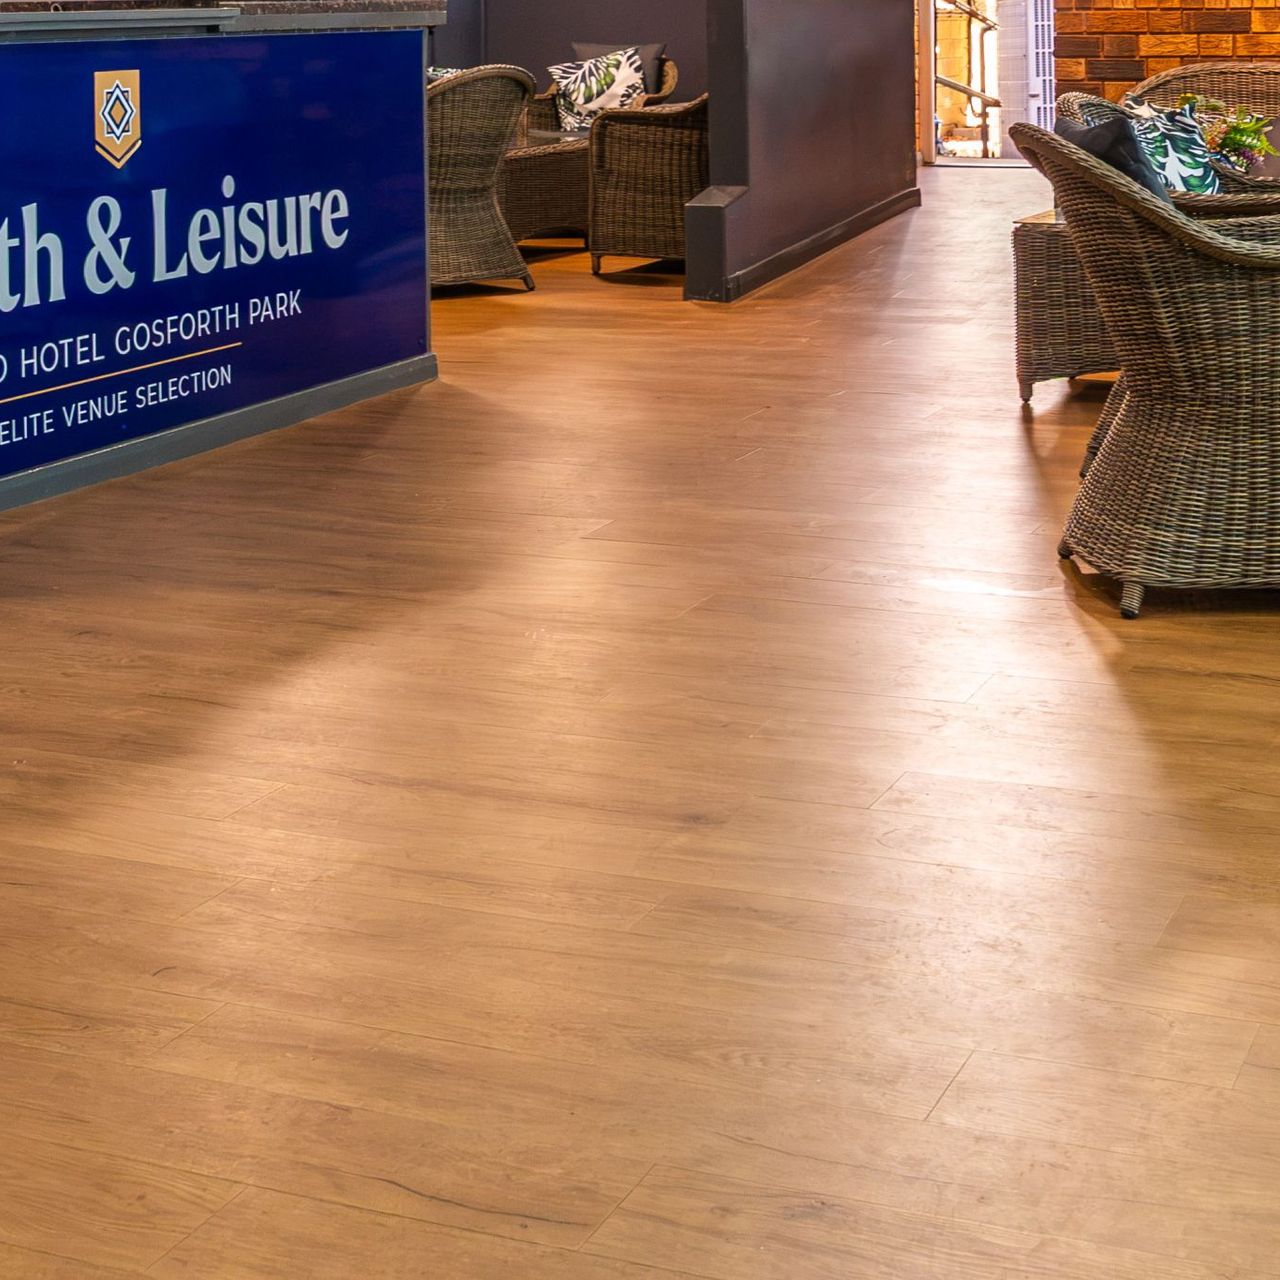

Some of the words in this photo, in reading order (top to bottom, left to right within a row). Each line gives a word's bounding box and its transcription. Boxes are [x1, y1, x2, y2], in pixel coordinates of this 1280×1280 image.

[83, 195, 136, 295] &
[151, 174, 350, 283] Leisure
[20, 332, 106, 378] HOTEL
[114, 302, 239, 355] GOSFORTH
[249, 288, 303, 325] PARK
[62, 390, 128, 427] VENUE
[135, 364, 232, 409] SELECTION
